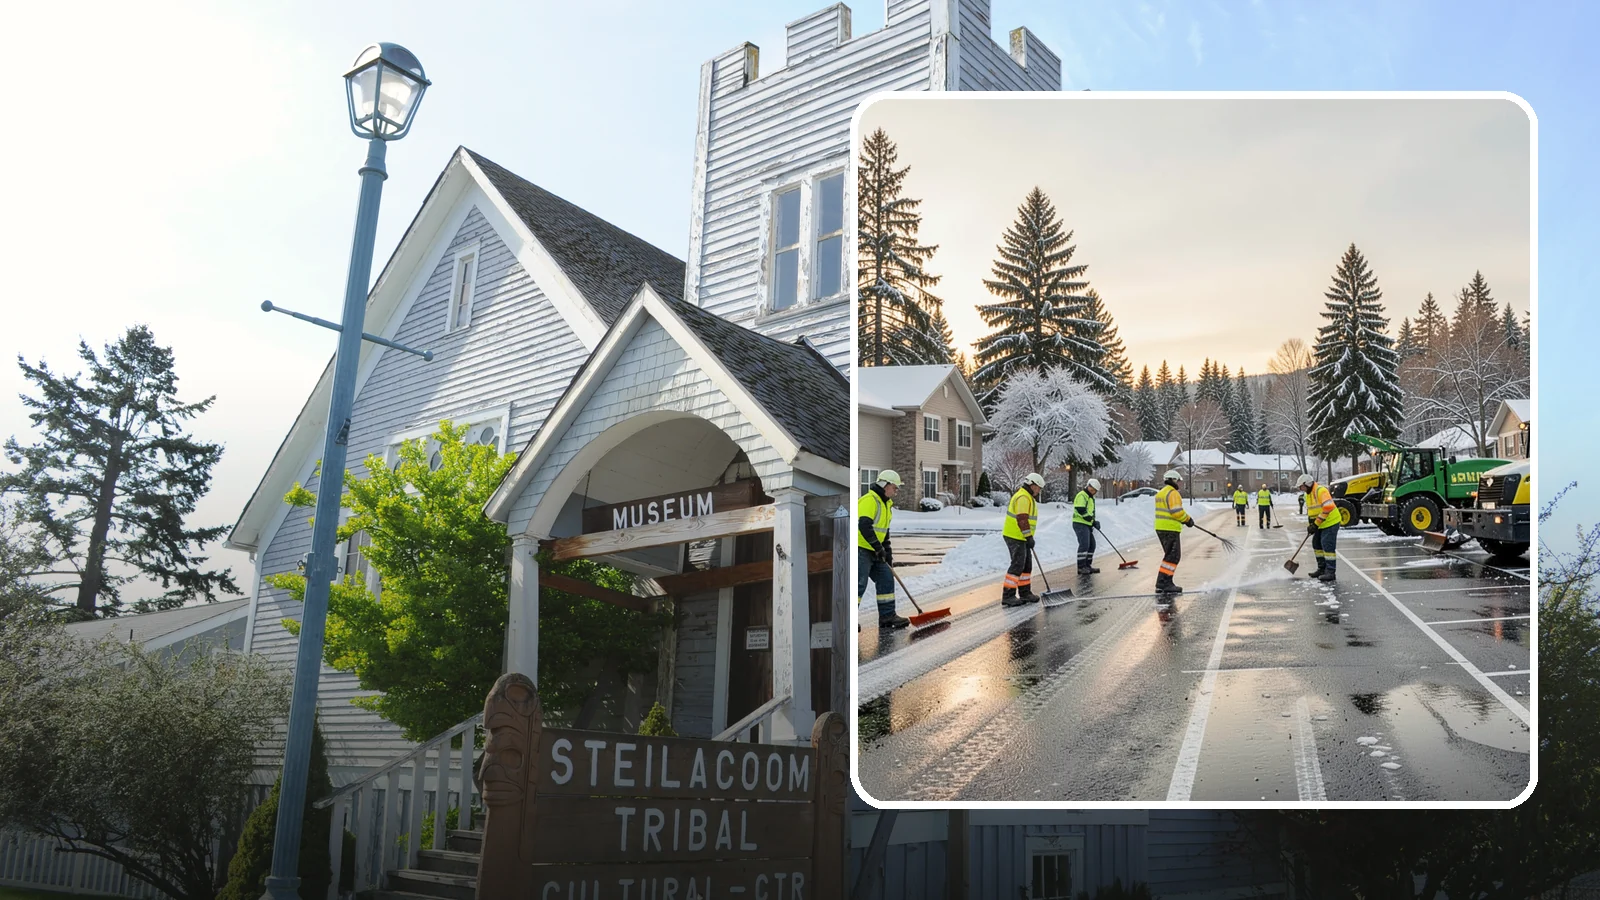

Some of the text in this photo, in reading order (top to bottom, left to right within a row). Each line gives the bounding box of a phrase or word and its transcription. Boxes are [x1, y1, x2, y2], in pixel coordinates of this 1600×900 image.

[613, 491, 713, 531] MUSEUM
[551, 738, 810, 792] STEILACOOM
[615, 806, 757, 852] TRIBAL
